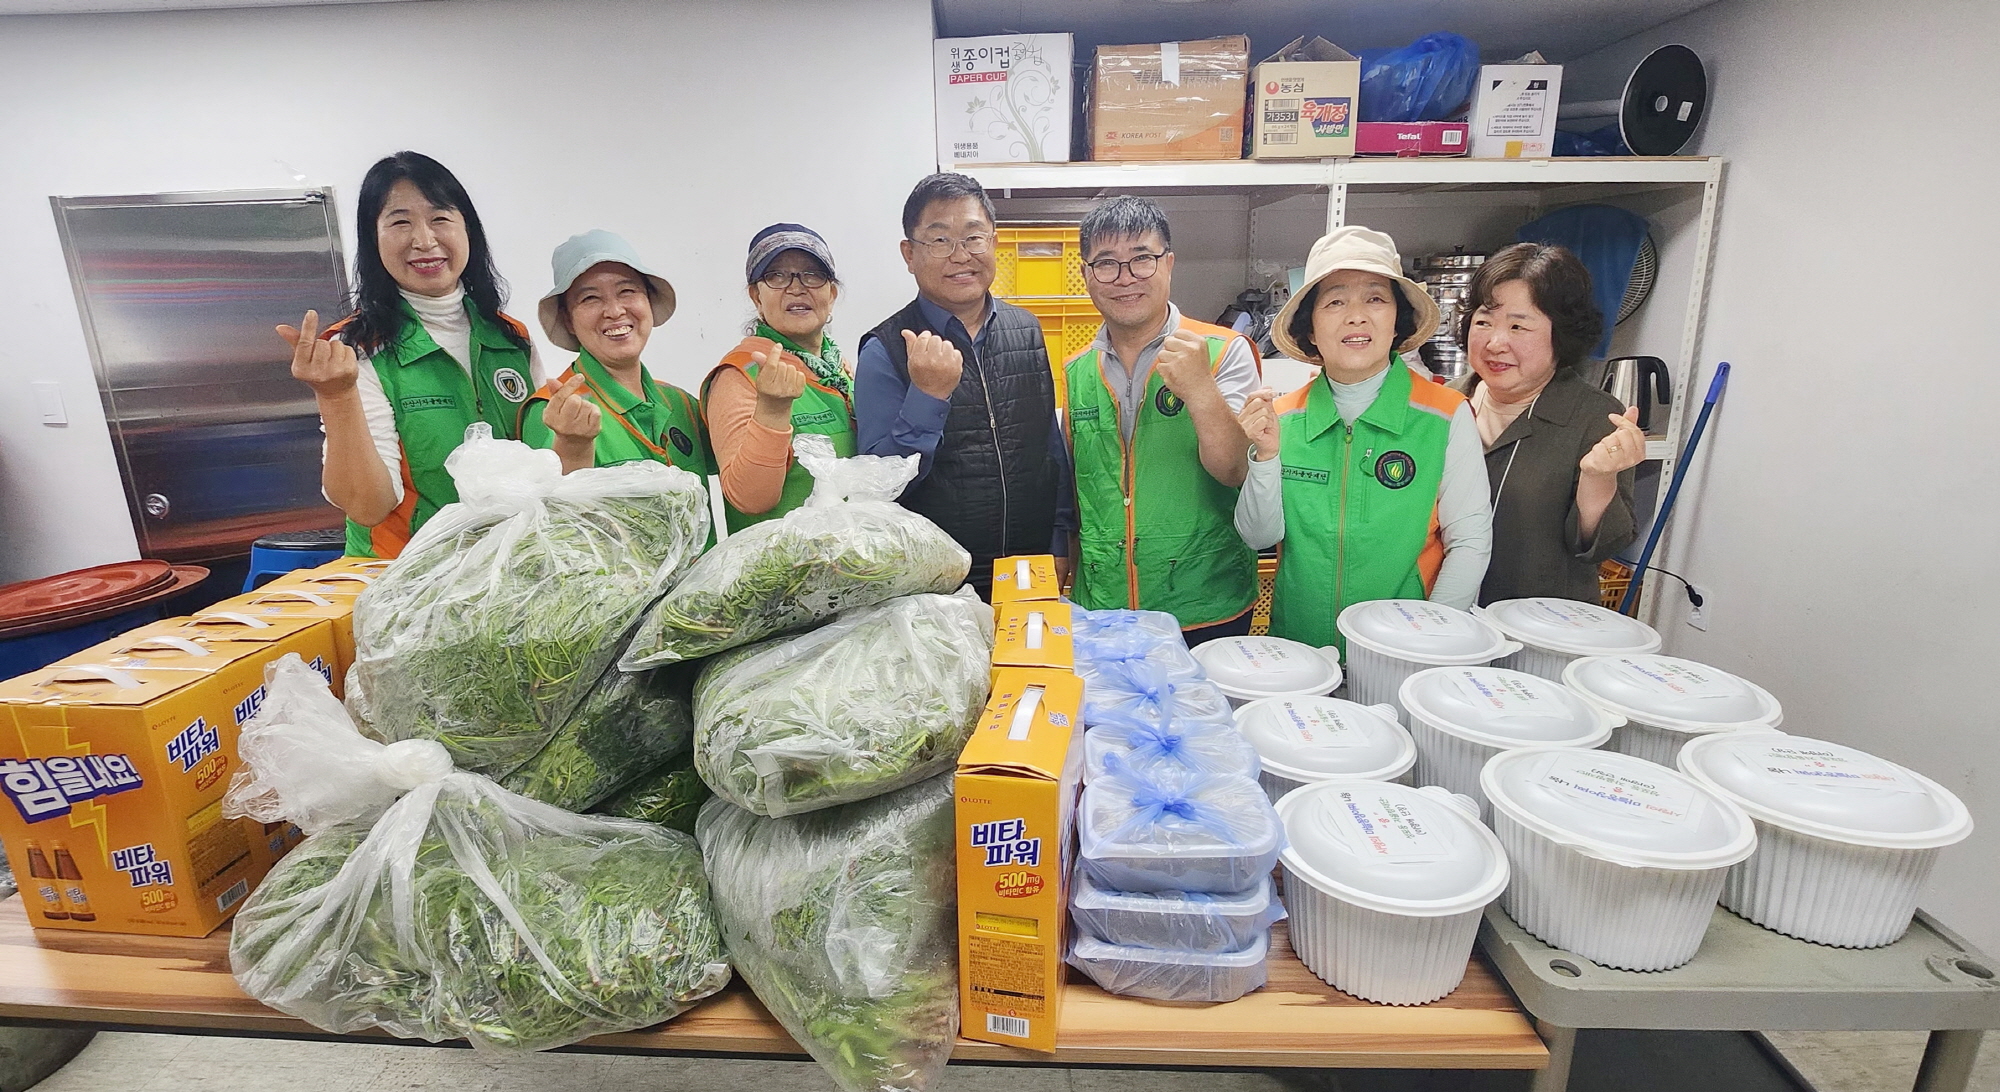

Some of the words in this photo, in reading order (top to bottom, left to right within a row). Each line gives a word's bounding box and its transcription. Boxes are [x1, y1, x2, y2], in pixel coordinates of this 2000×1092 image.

[962, 46, 1010, 71] 종이컵
[950, 74, 983, 83] PAPER
[986, 72, 1007, 81] CUP
[1281, 83, 1304, 94] 농심
[1267, 112, 1296, 121] 가3531
[1300, 101, 1348, 123] 육개장
[1316, 124, 1344, 134] 사발면
[953, 142, 979, 150] 위생용품
[167, 718, 205, 763] 비타
[183, 727, 220, 772] 파워
[968, 797, 992, 805] LOTTE
[972, 819, 1025, 846] 비타
[111, 844, 154, 871] 비타
[985, 839, 1039, 866] 파워
[131, 861, 174, 887] 파워
[999, 871, 1040, 889] 500mg
